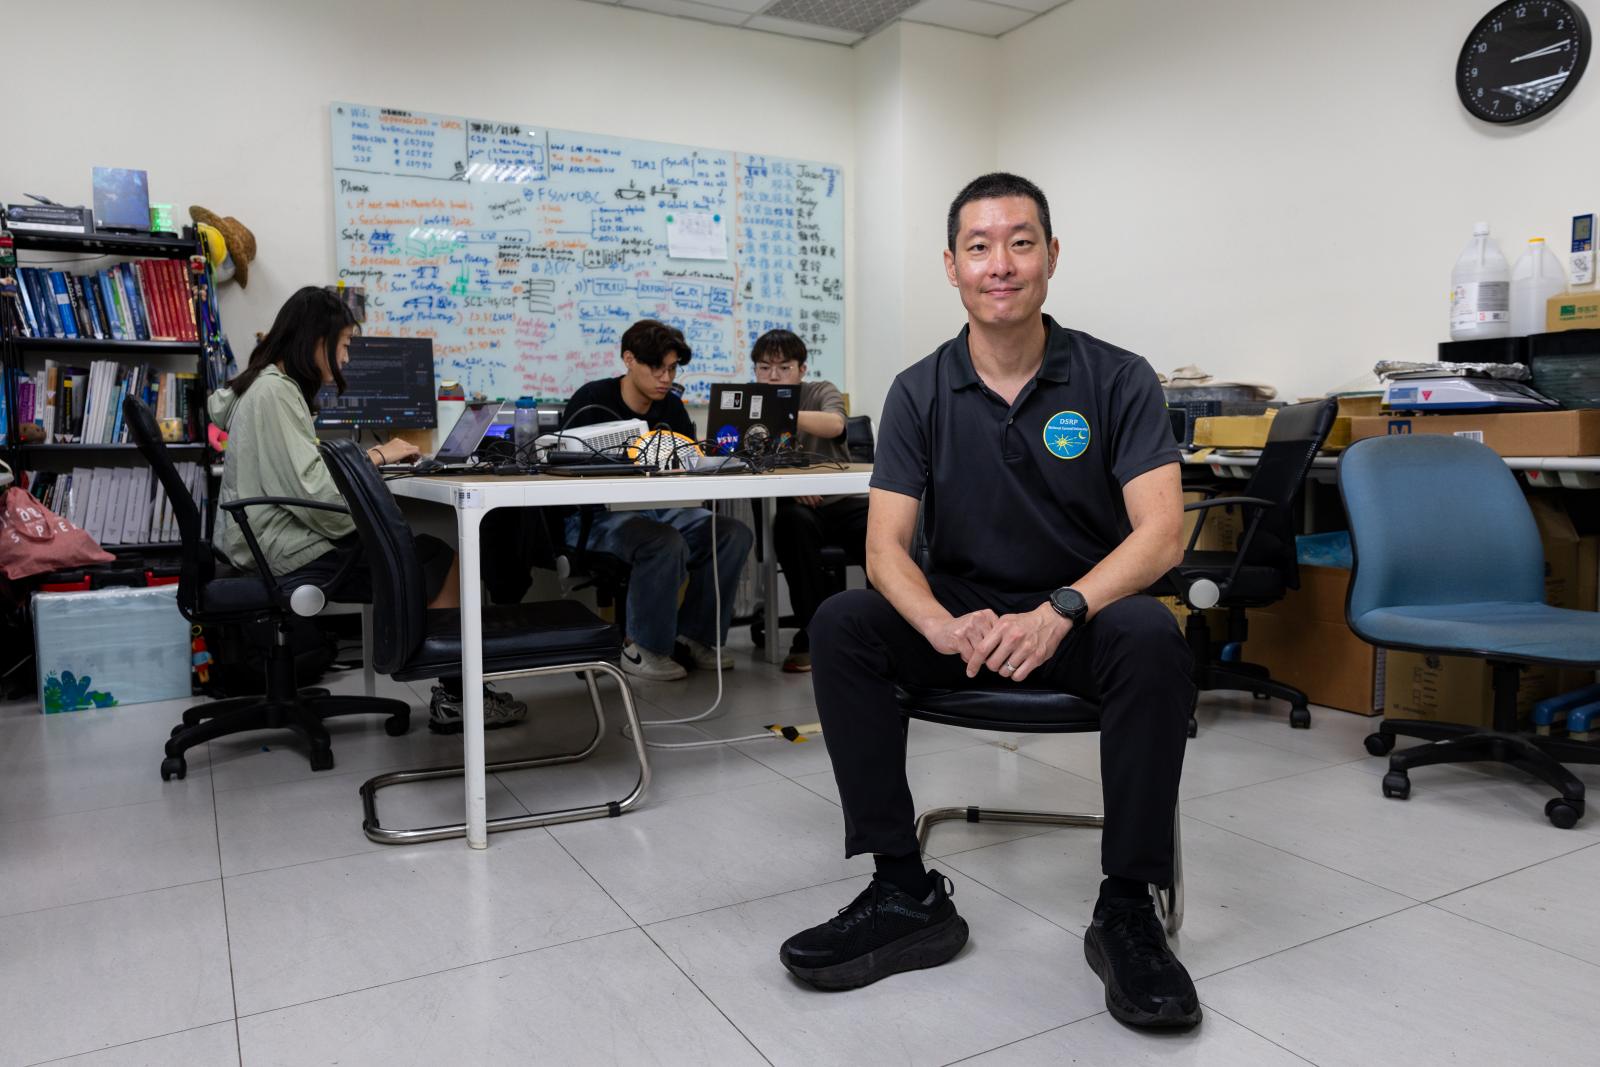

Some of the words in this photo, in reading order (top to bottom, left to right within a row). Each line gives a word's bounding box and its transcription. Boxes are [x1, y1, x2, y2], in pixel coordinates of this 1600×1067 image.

[1516, 7, 1527, 18] 12
[1543, 7, 1548, 17] 1
[1493, 22, 1502, 32] 11
[1557, 19, 1564, 30] 2
[1478, 42, 1487, 53] 10
[1563, 44, 1570, 52] 3
[1471, 67, 1478, 77] 9
[1477, 87, 1484, 97] 8
[1493, 100, 1499, 110] 7
[1515, 101, 1522, 111] 6
